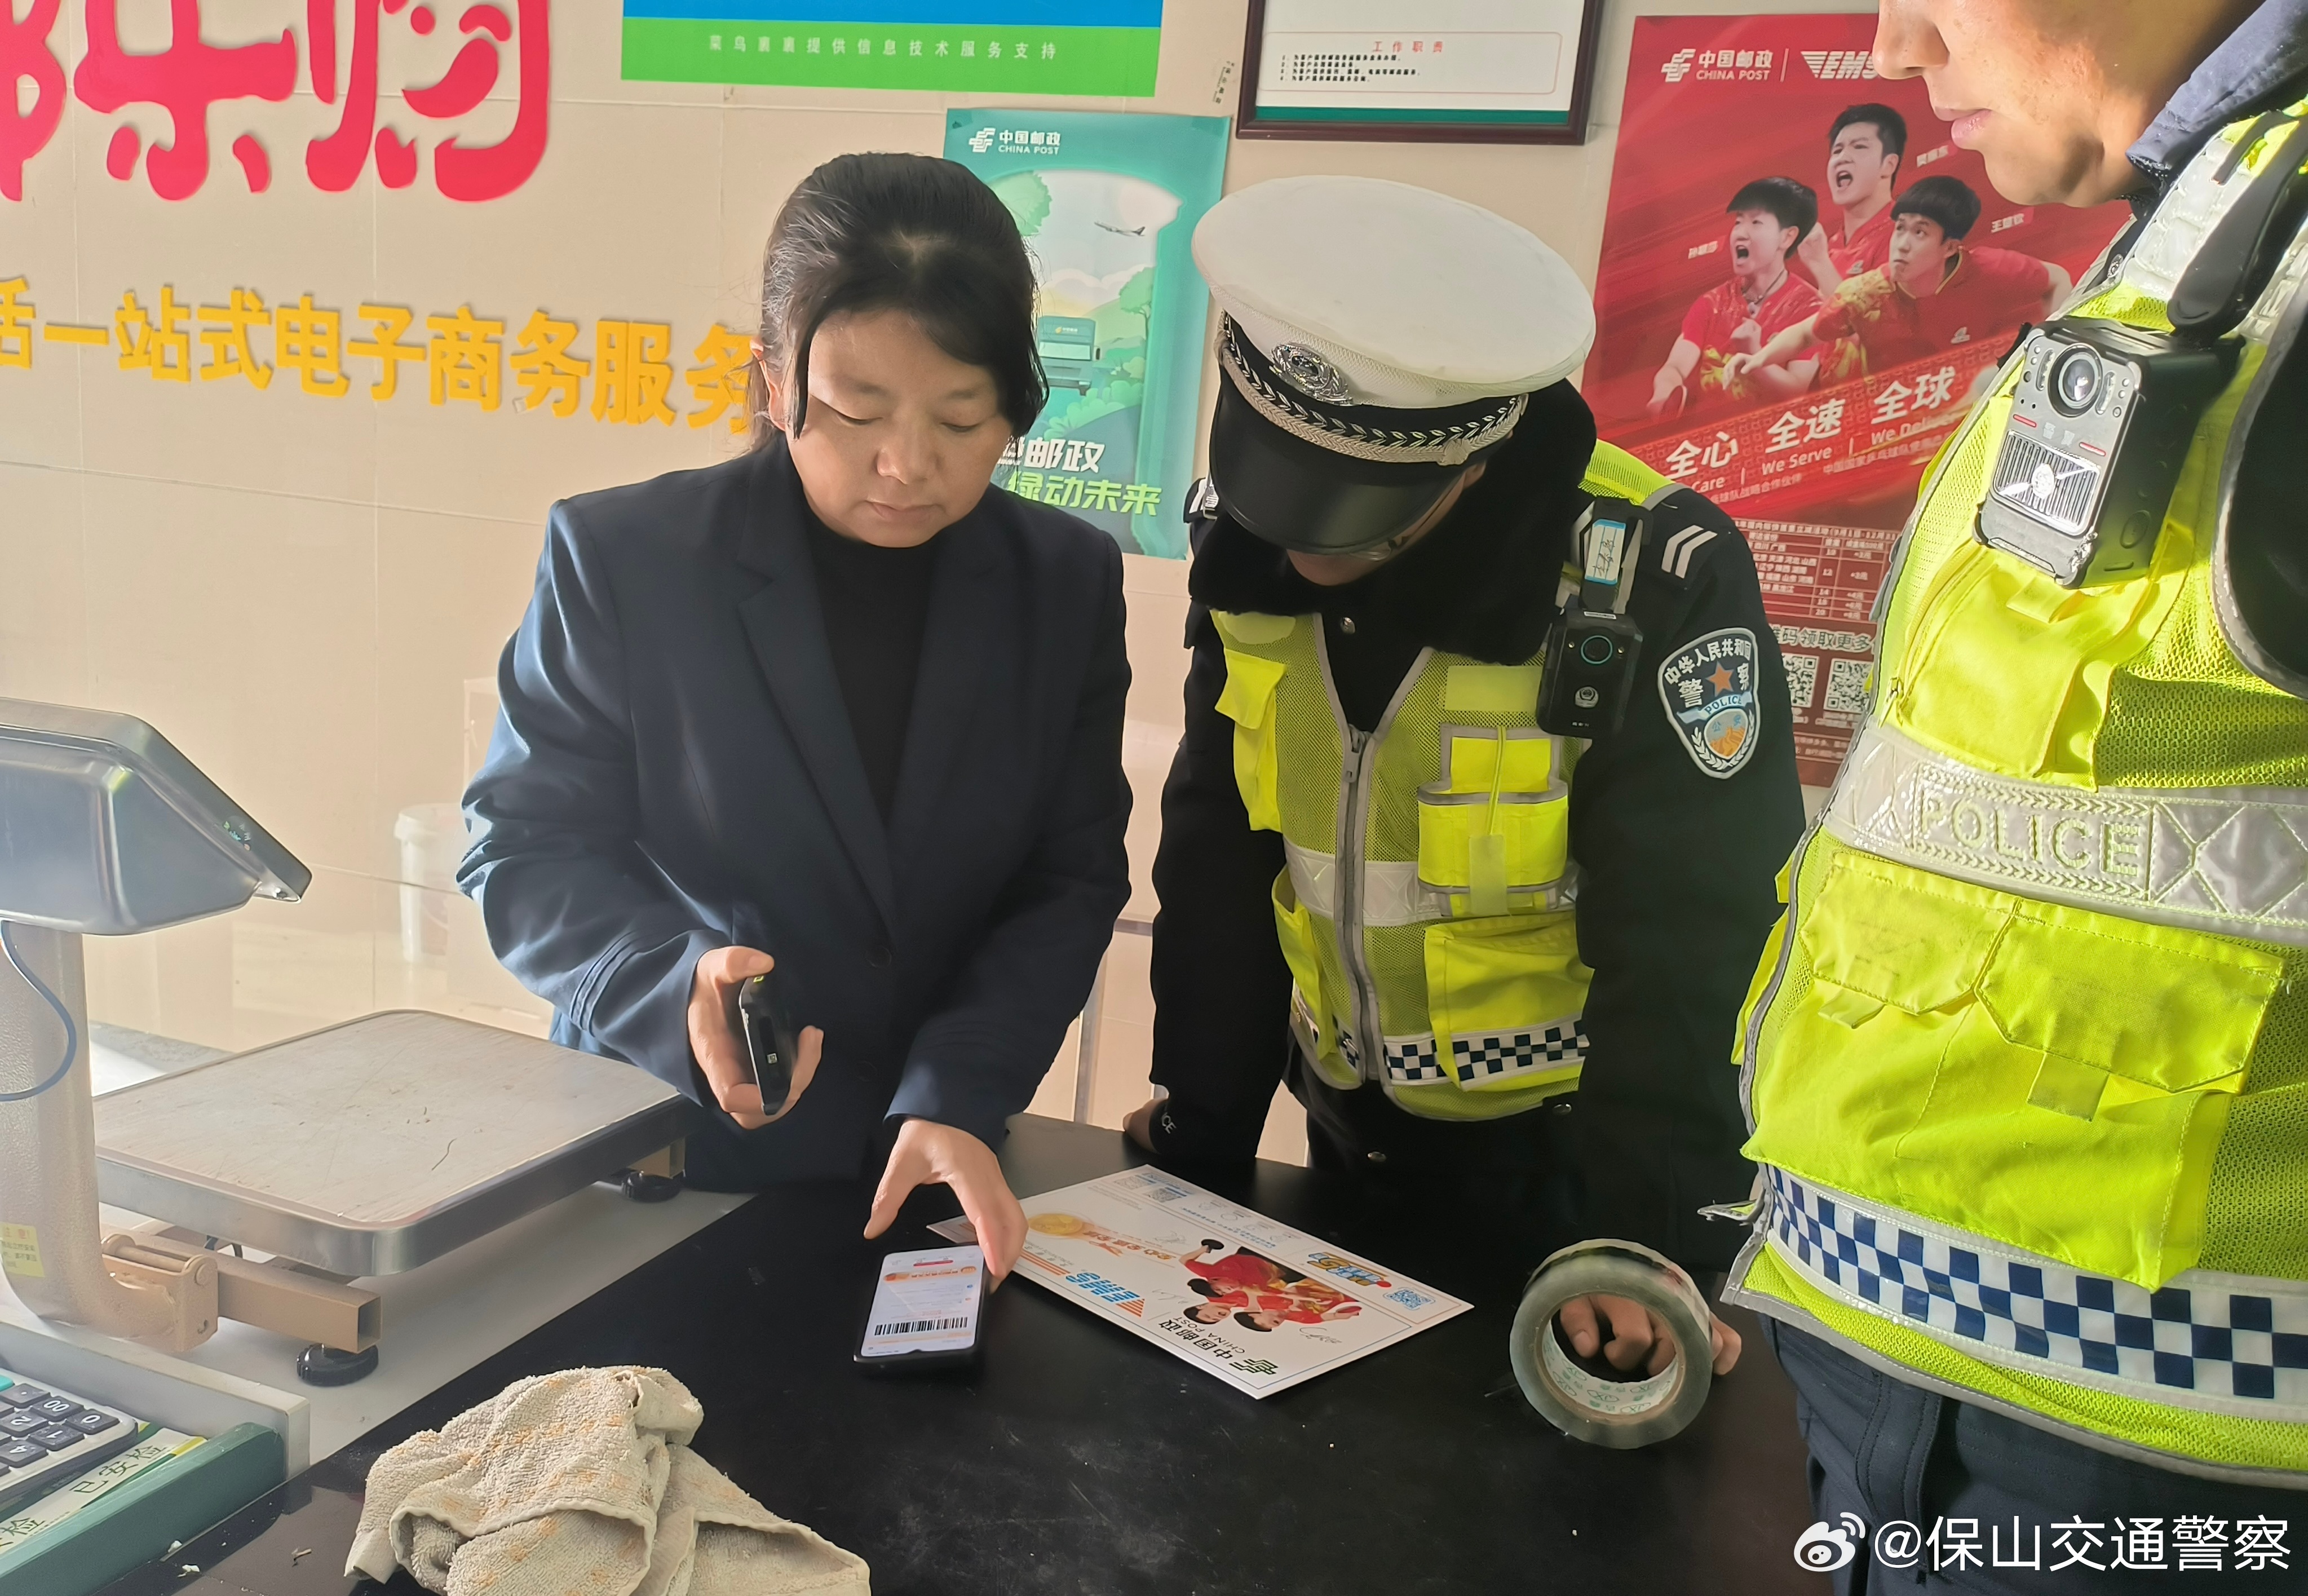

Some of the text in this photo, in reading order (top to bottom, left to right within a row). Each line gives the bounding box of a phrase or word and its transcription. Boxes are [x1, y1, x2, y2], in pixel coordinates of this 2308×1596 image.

[1699, 50, 1773, 68] 中国邮政
[1696, 70, 1771, 81] CHINA POST
[998, 145, 1059, 155] CHINA POST
[999, 130, 1060, 146] 中国邮政
[1664, 366, 1956, 480] 全心 全速 全球
[1762, 460, 1785, 475] We
[1789, 446, 1832, 468] Serve
[1871, 428, 1896, 445] We
[1008, 471, 1162, 516] 绿动未来
[1704, 695, 1743, 715] POLICE
[1920, 796, 2143, 878] POLICE
[1064, 1272, 1140, 1303] EMS
[1158, 1319, 1234, 1360] 中国邮政
[1173, 1315, 1246, 1354] CHINA POST
[11, 1416, 32, 1425] 2
[0, 1517, 46, 1547] 检
